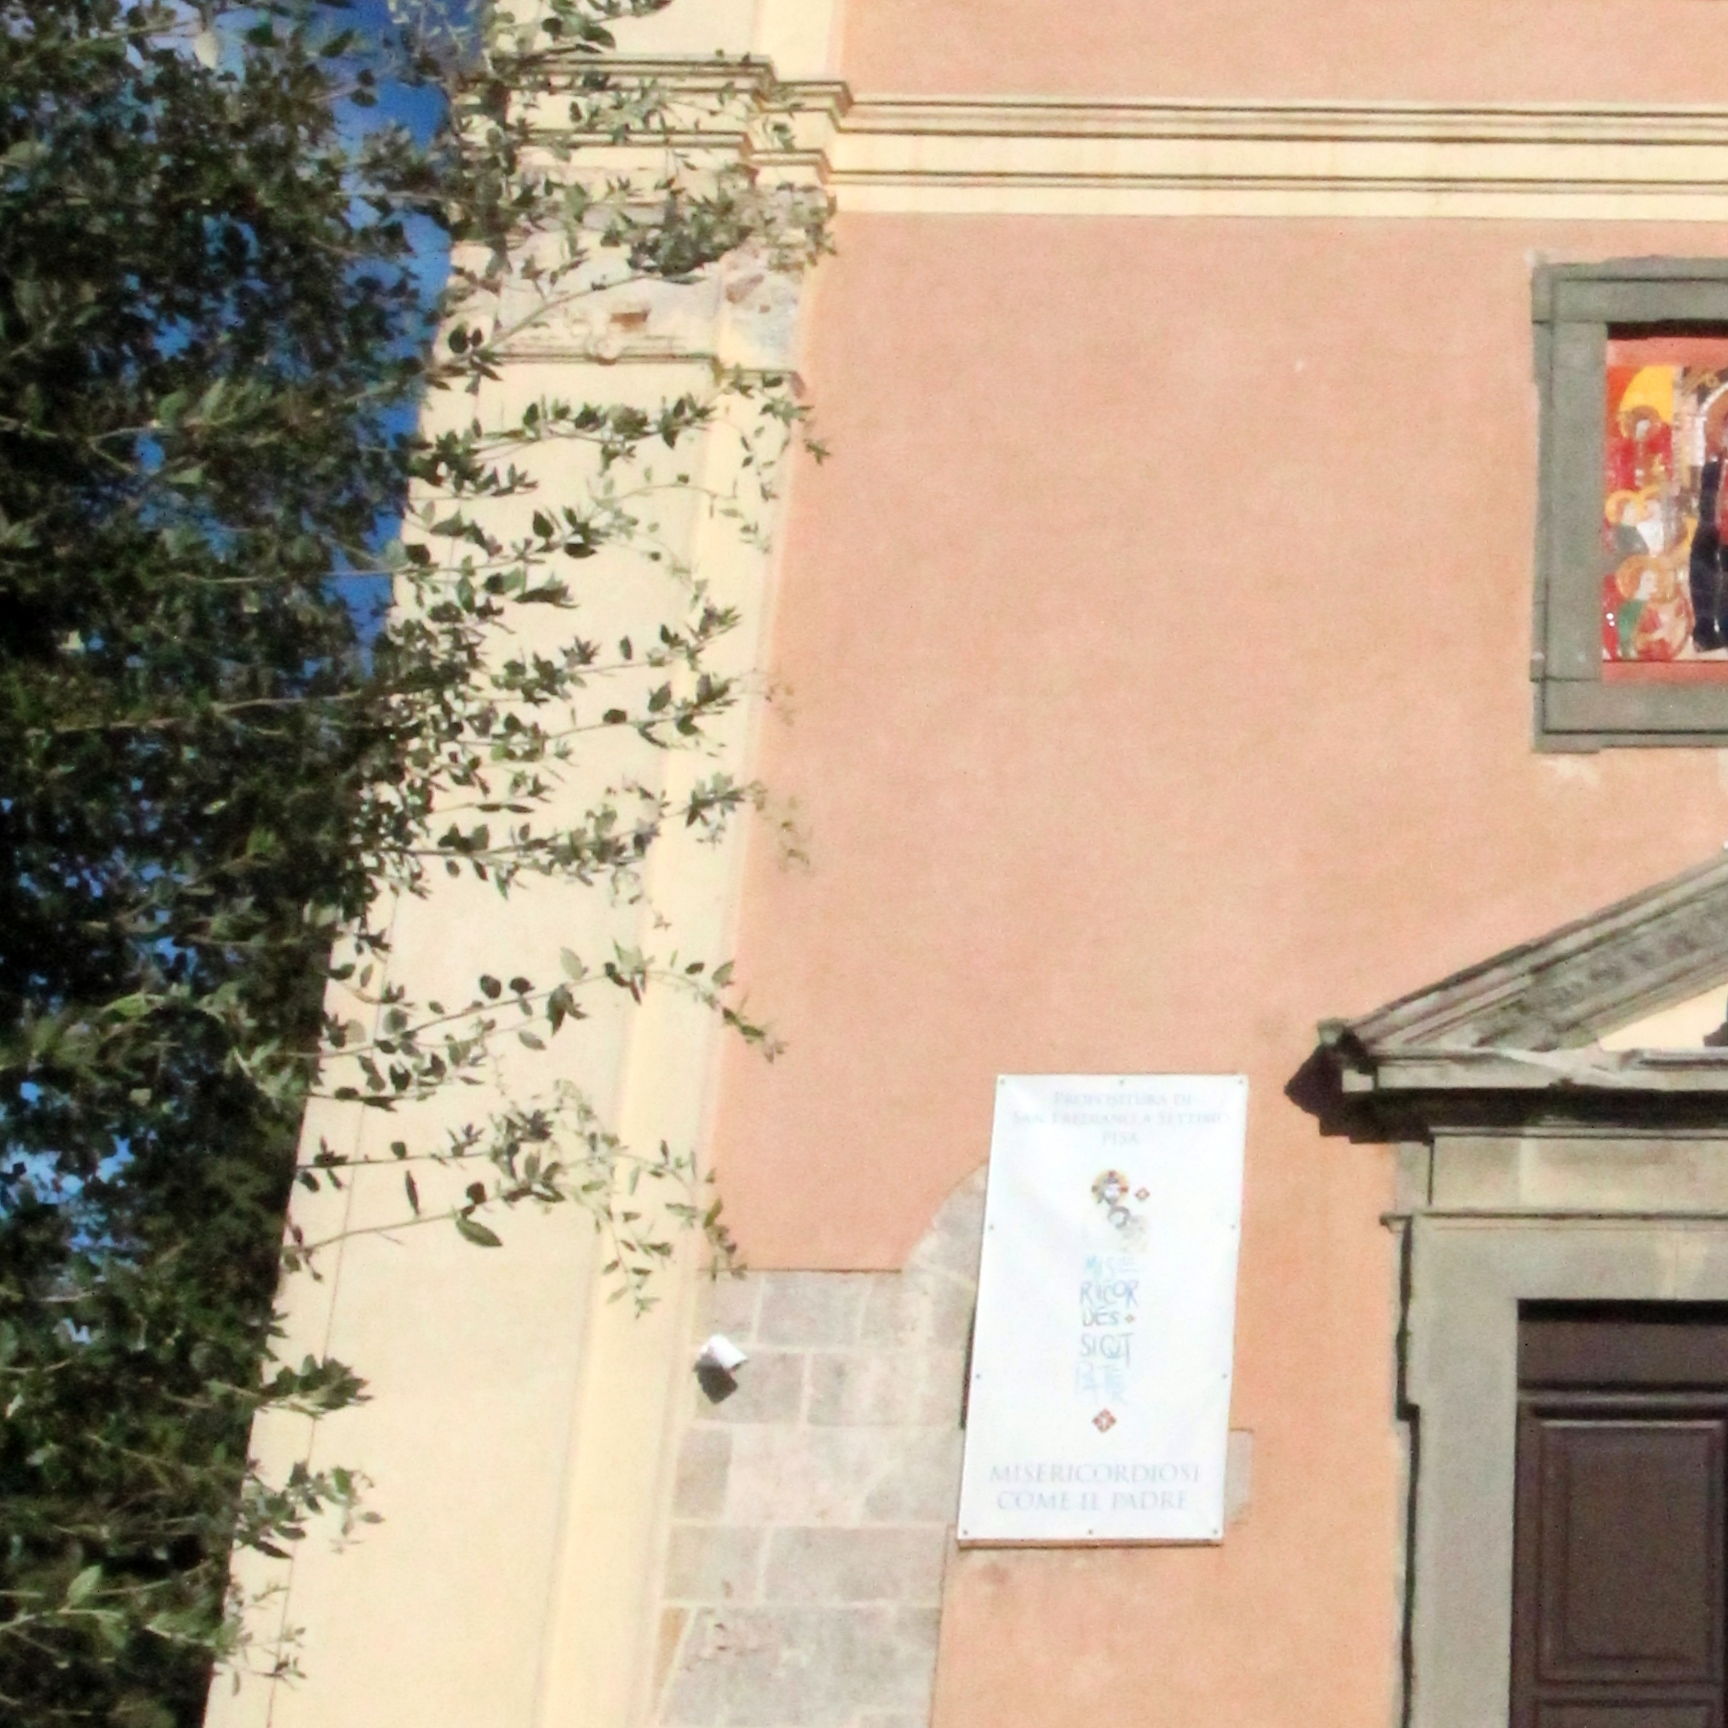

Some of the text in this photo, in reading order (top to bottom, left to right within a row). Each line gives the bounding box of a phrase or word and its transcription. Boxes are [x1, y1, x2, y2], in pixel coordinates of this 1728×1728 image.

[989, 1463, 1199, 1483] MISERICORDIOSI
[997, 1489, 1070, 1510] COME
[1112, 1489, 1189, 1510] PADRE
